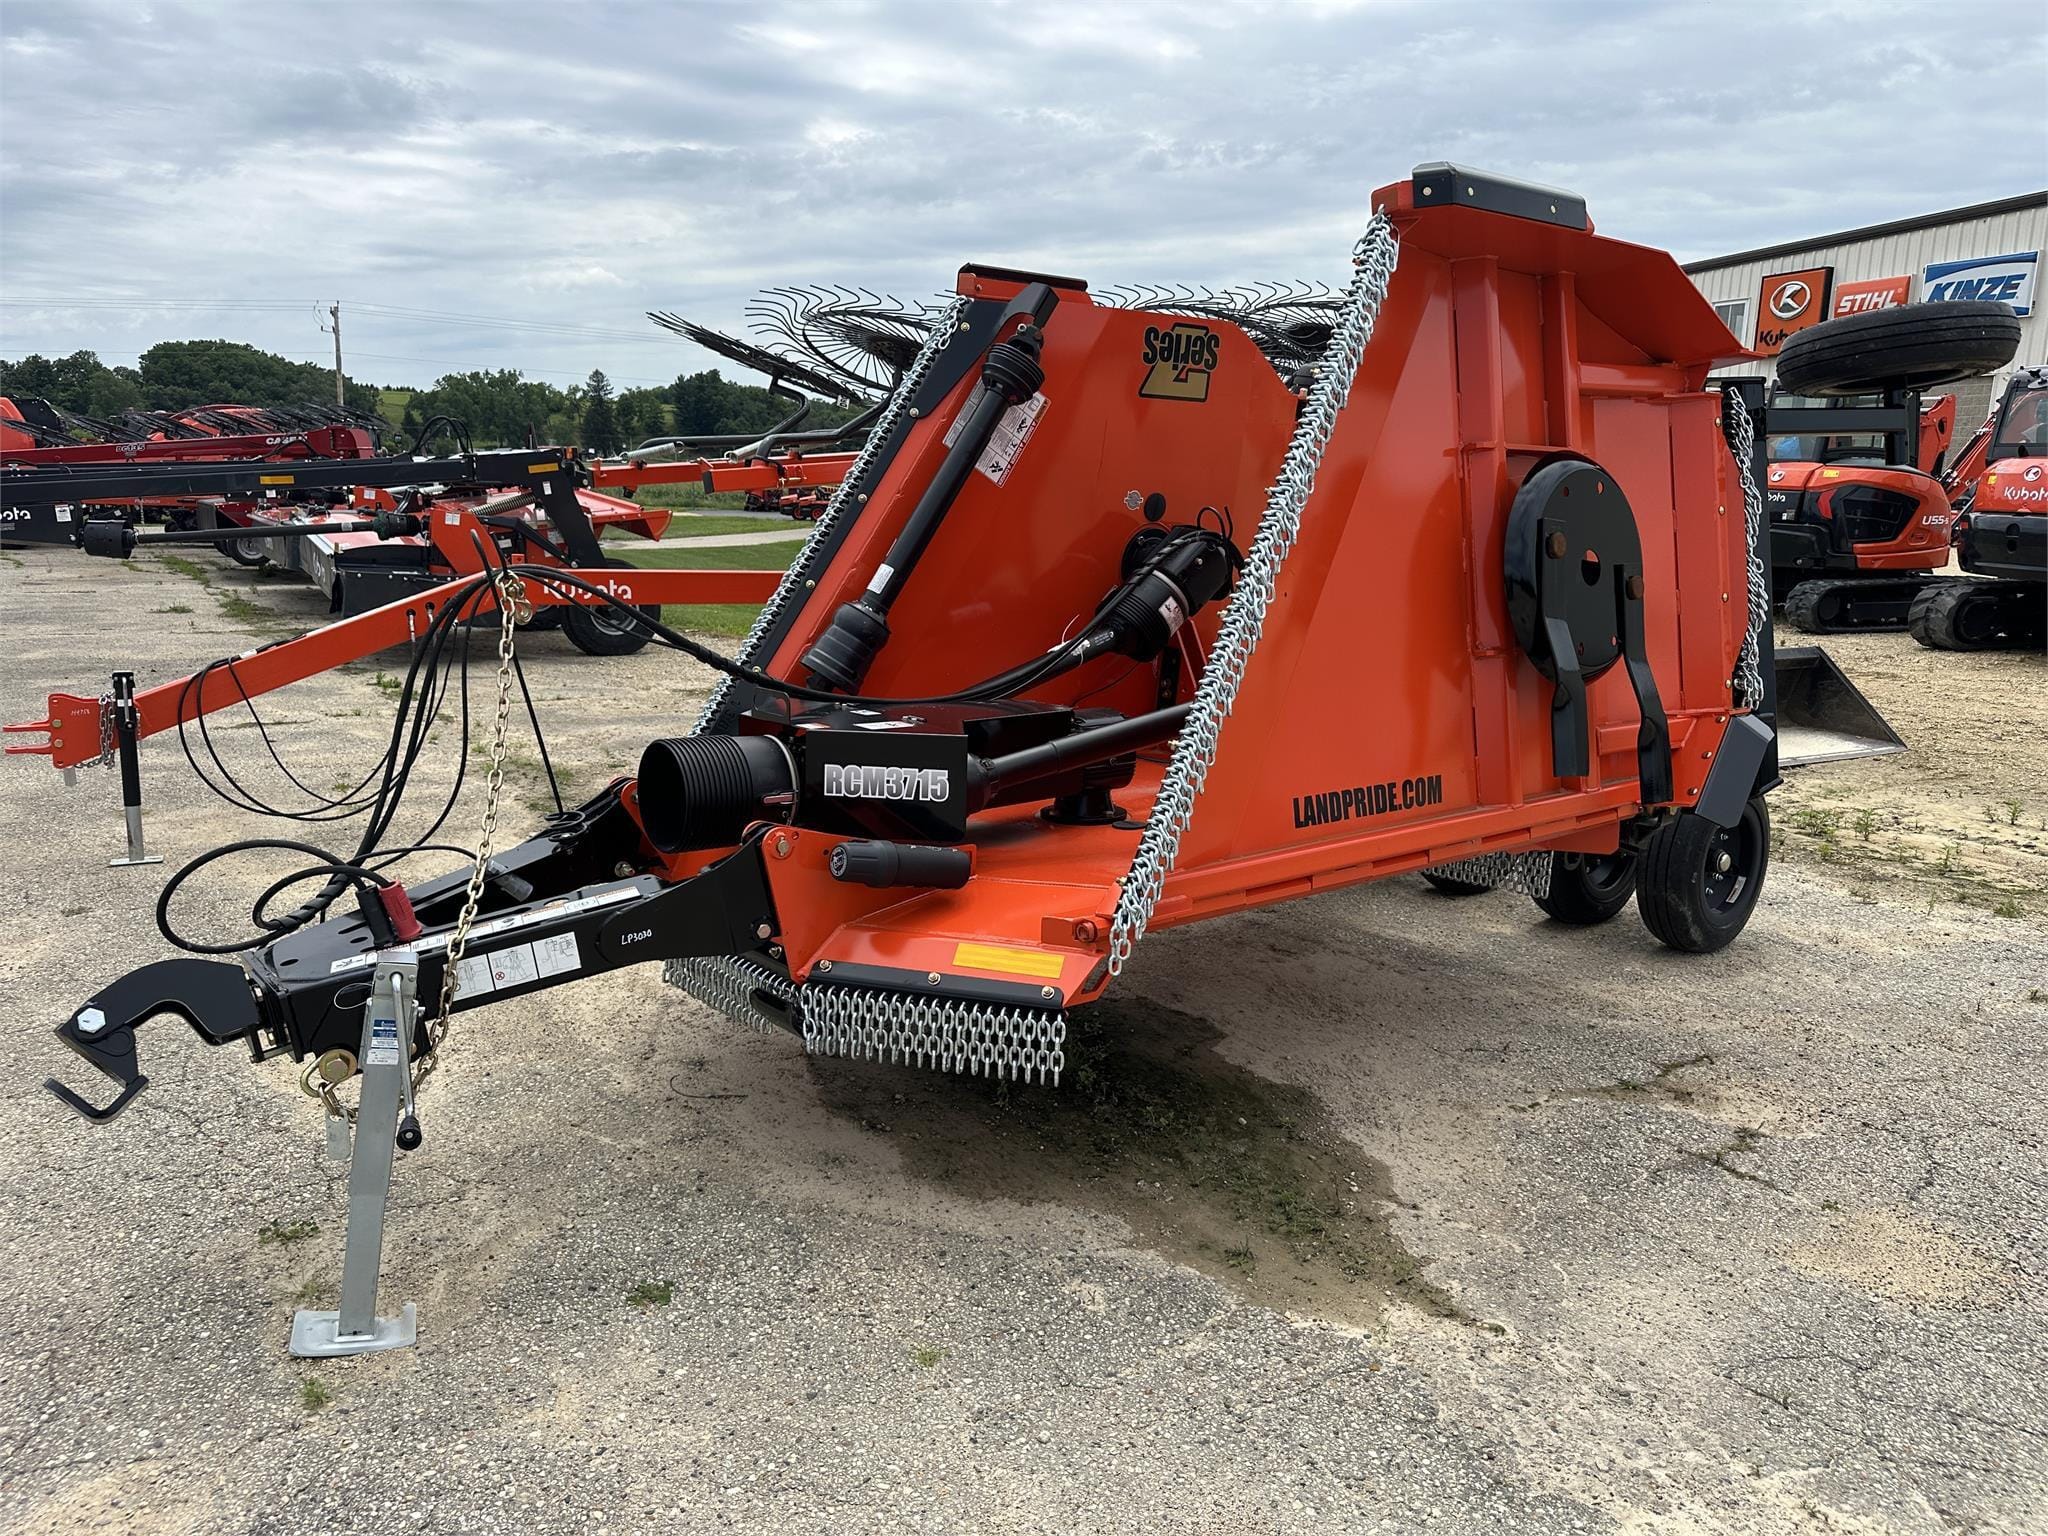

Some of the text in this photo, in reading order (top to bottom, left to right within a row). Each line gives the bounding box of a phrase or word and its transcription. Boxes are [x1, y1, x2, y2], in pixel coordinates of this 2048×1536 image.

[1837, 288, 1897, 313] STIHL
[1927, 273, 2027, 303] KINZE
[1759, 326, 1804, 346] Kub
[0, 507, 31, 521] ota
[824, 764, 950, 802] RCM3715
[1293, 775, 1442, 829] LANDPRIDE.COM
[621, 928, 652, 945] LP3030
